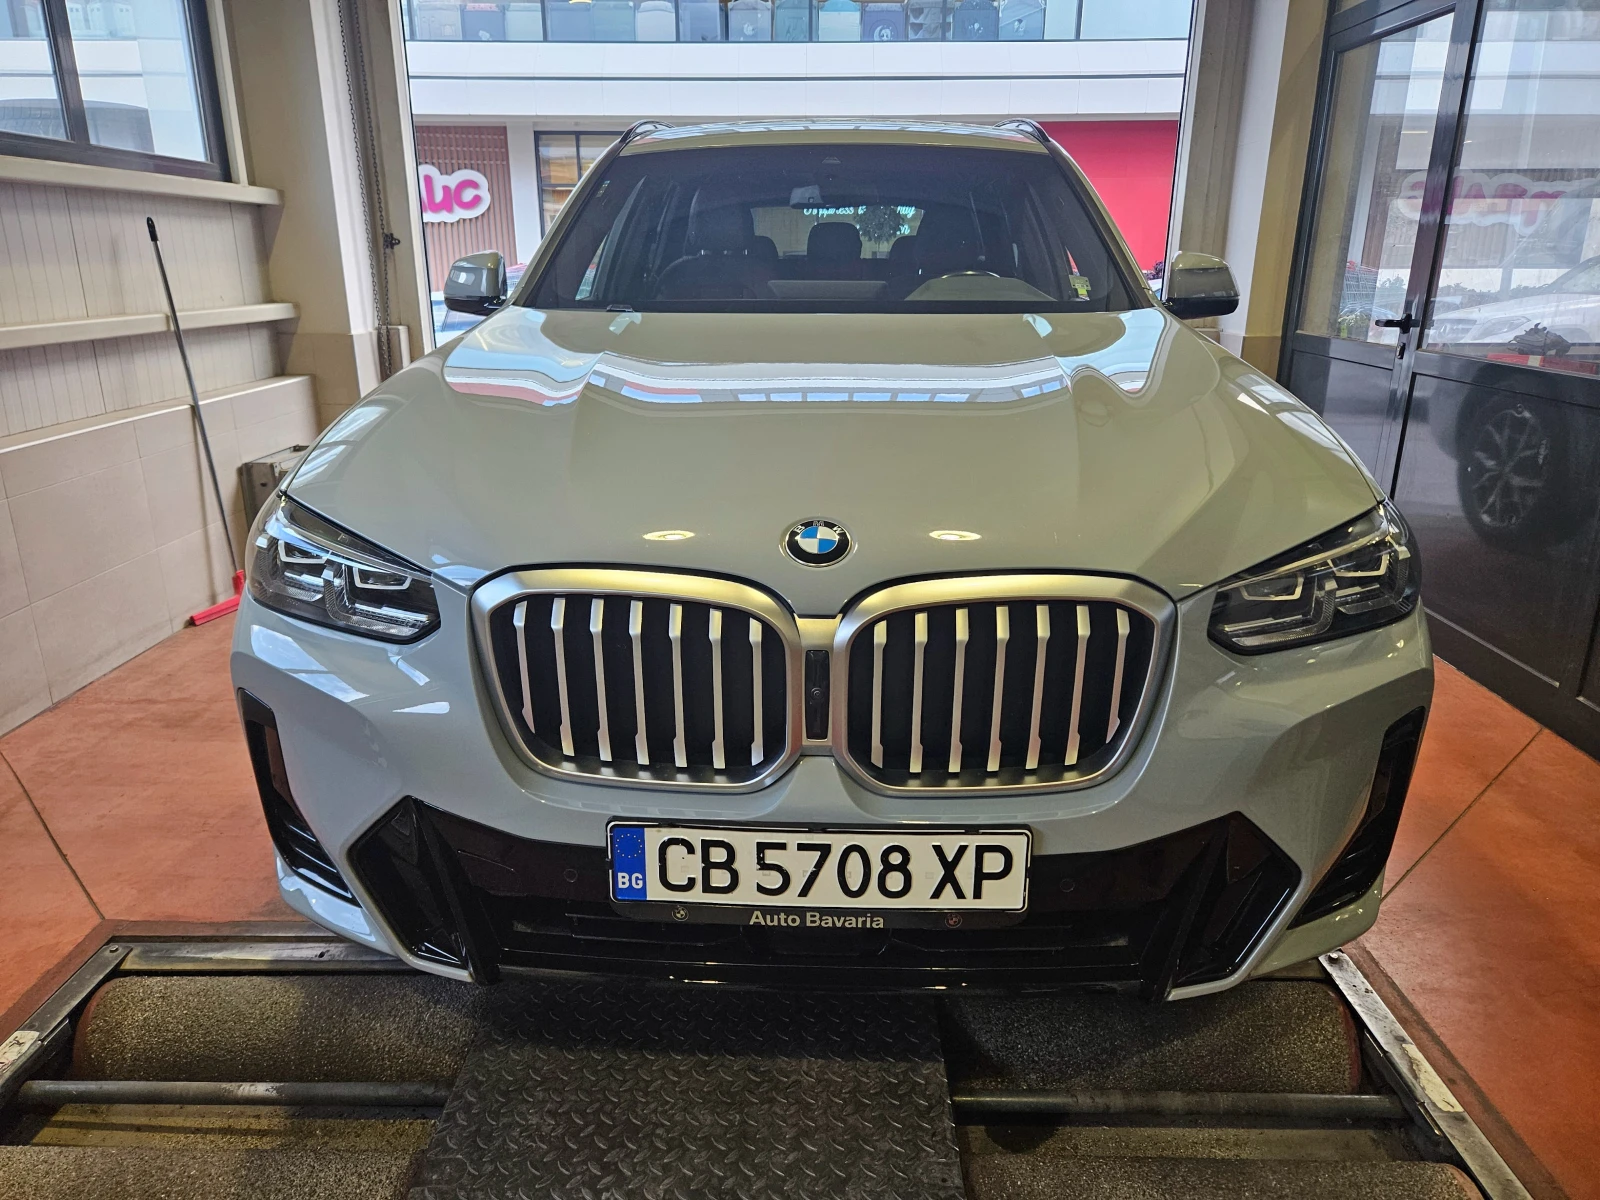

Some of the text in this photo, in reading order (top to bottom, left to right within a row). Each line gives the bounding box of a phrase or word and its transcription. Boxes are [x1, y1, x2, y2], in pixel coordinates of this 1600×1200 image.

[658, 836, 1014, 900] CB 5708 XP
[617, 872, 644, 889] BG
[749, 910, 884, 929] Auto Bavaria
